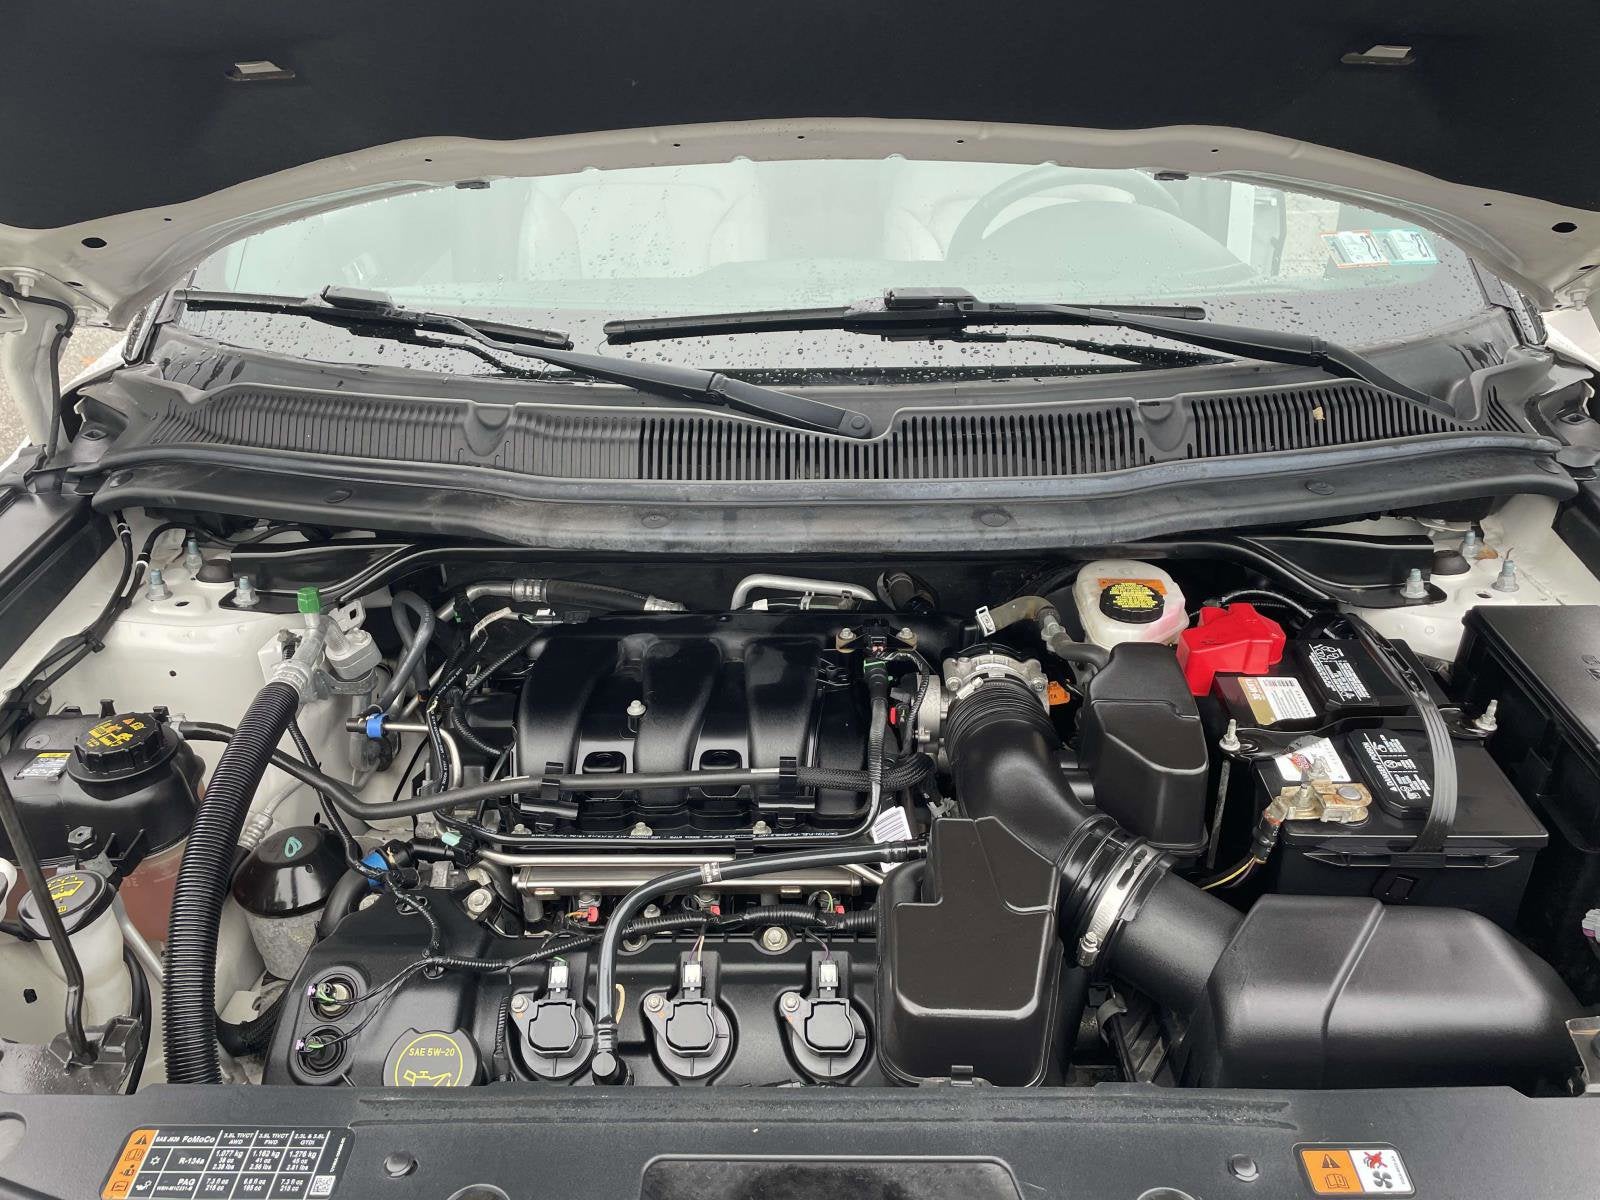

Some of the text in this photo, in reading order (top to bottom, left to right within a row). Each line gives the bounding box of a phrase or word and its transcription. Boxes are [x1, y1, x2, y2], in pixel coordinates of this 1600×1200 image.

[409, 1047, 455, 1057] SAE 5W-20
[182, 1135, 216, 1143] FoMoCo
[234, 1149, 244, 1159] kg
[271, 1149, 281, 1159] kg
[308, 1150, 318, 1160] kg
[178, 1157, 205, 1165] R-134a
